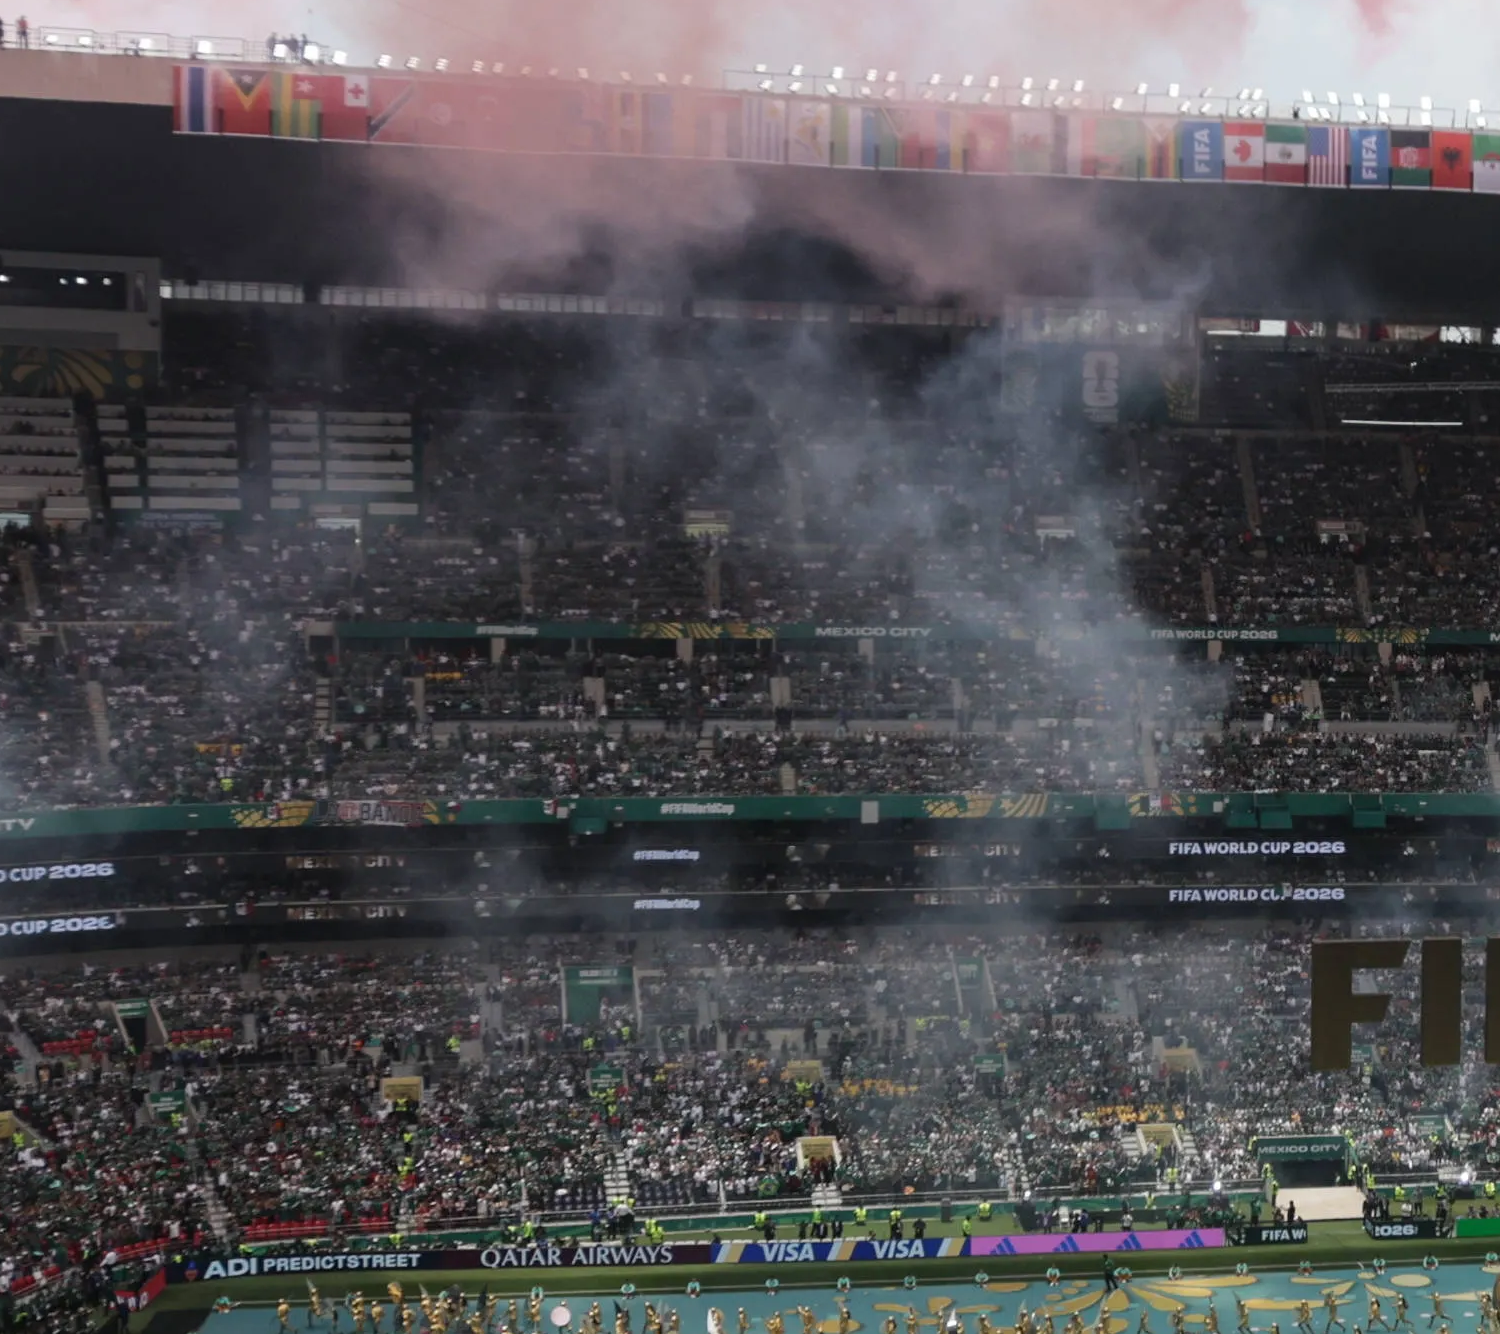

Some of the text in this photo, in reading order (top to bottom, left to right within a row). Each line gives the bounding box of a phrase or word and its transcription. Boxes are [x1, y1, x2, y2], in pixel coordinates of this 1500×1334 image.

[1194, 127, 1211, 174] FIFA
[1361, 134, 1379, 180] FIFA
[814, 626, 933, 638] MEXICO CITY
[1150, 629, 1279, 640] FIFA WORLD CUP 2026
[1168, 841, 1346, 855] FIFA WORLD CUP 2026
[8, 866, 47, 883] CUP
[48, 862, 116, 880] 2026
[1168, 889, 1202, 902] FIFA
[1203, 889, 1258, 902] WORLD
[1292, 888, 1346, 901] 2026
[10, 919, 49, 936] CUP
[1259, 1144, 1341, 1155] MEXICO CITY
[1261, 1228, 1291, 1242] FIFA
[480, 1246, 674, 1268] QATAR AIRWAYS
[761, 1243, 816, 1262] VISA
[870, 1240, 925, 1259] VISA
[203, 1253, 422, 1280] ADI PREDICTSTREET
